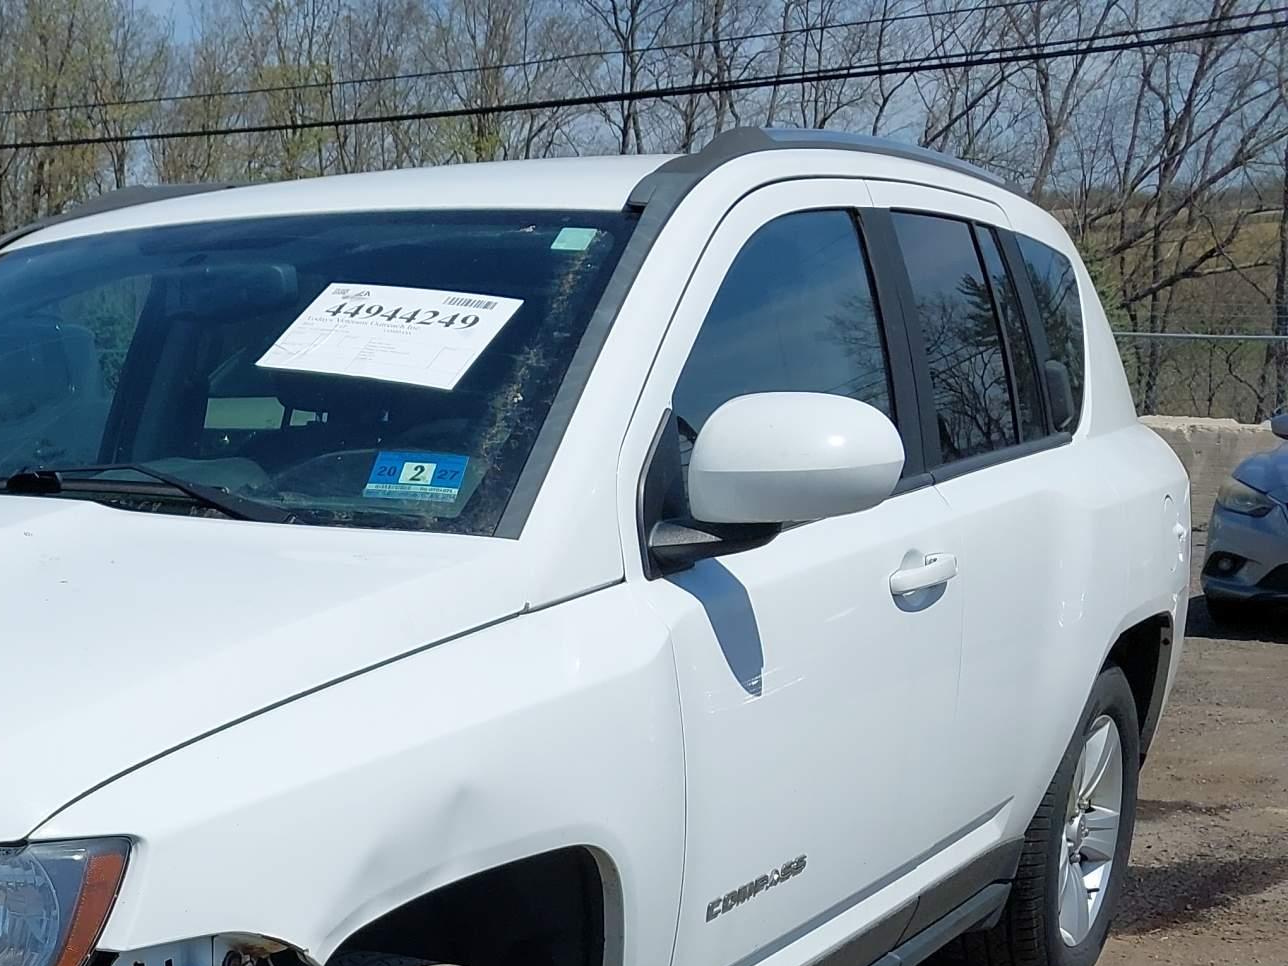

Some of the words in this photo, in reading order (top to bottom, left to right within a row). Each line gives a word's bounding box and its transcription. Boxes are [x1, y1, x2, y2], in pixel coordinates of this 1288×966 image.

[325, 302, 480, 330] 44944249
[377, 465, 398, 477] 20
[409, 465, 426, 482] 2
[437, 469, 460, 480] 27
[706, 853, 807, 923] COMPASS
